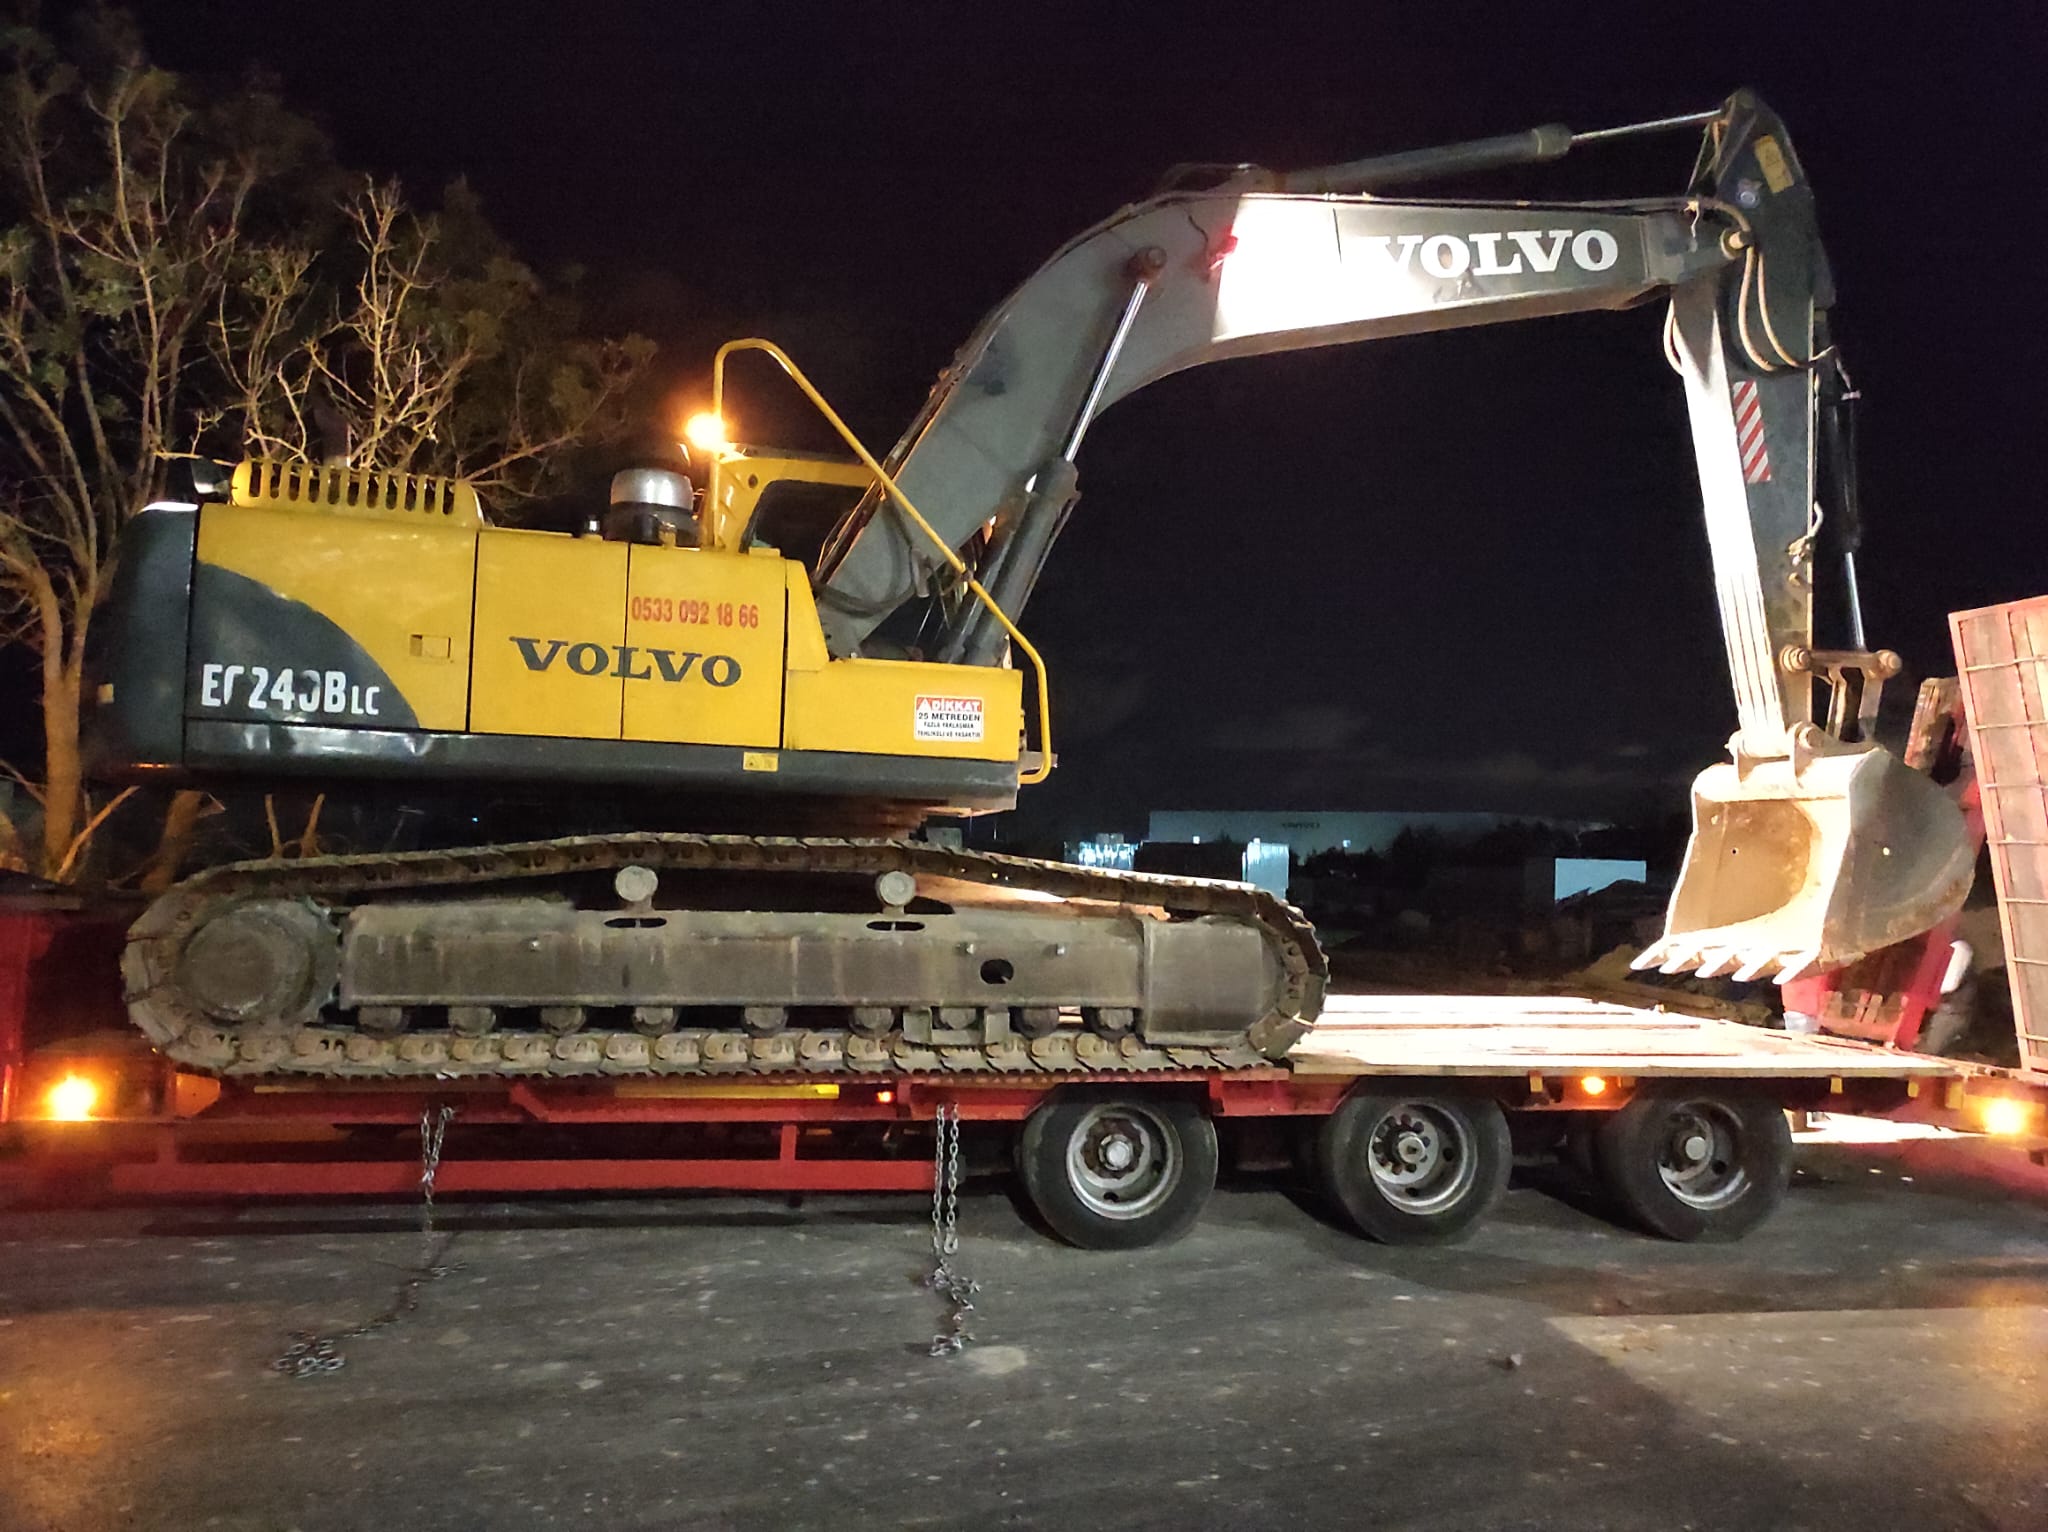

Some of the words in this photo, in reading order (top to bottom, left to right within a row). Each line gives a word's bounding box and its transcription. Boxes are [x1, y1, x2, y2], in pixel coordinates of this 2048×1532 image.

[1357, 229, 1619, 279] VOLVO
[631, 596, 673, 623] 0533
[679, 599, 710, 625] 092
[716, 603, 733, 628] 18
[738, 604, 759, 629] 66
[508, 635, 742, 688] VOLVO
[918, 712, 929, 720] 25
[931, 713, 981, 721] METREDEN
